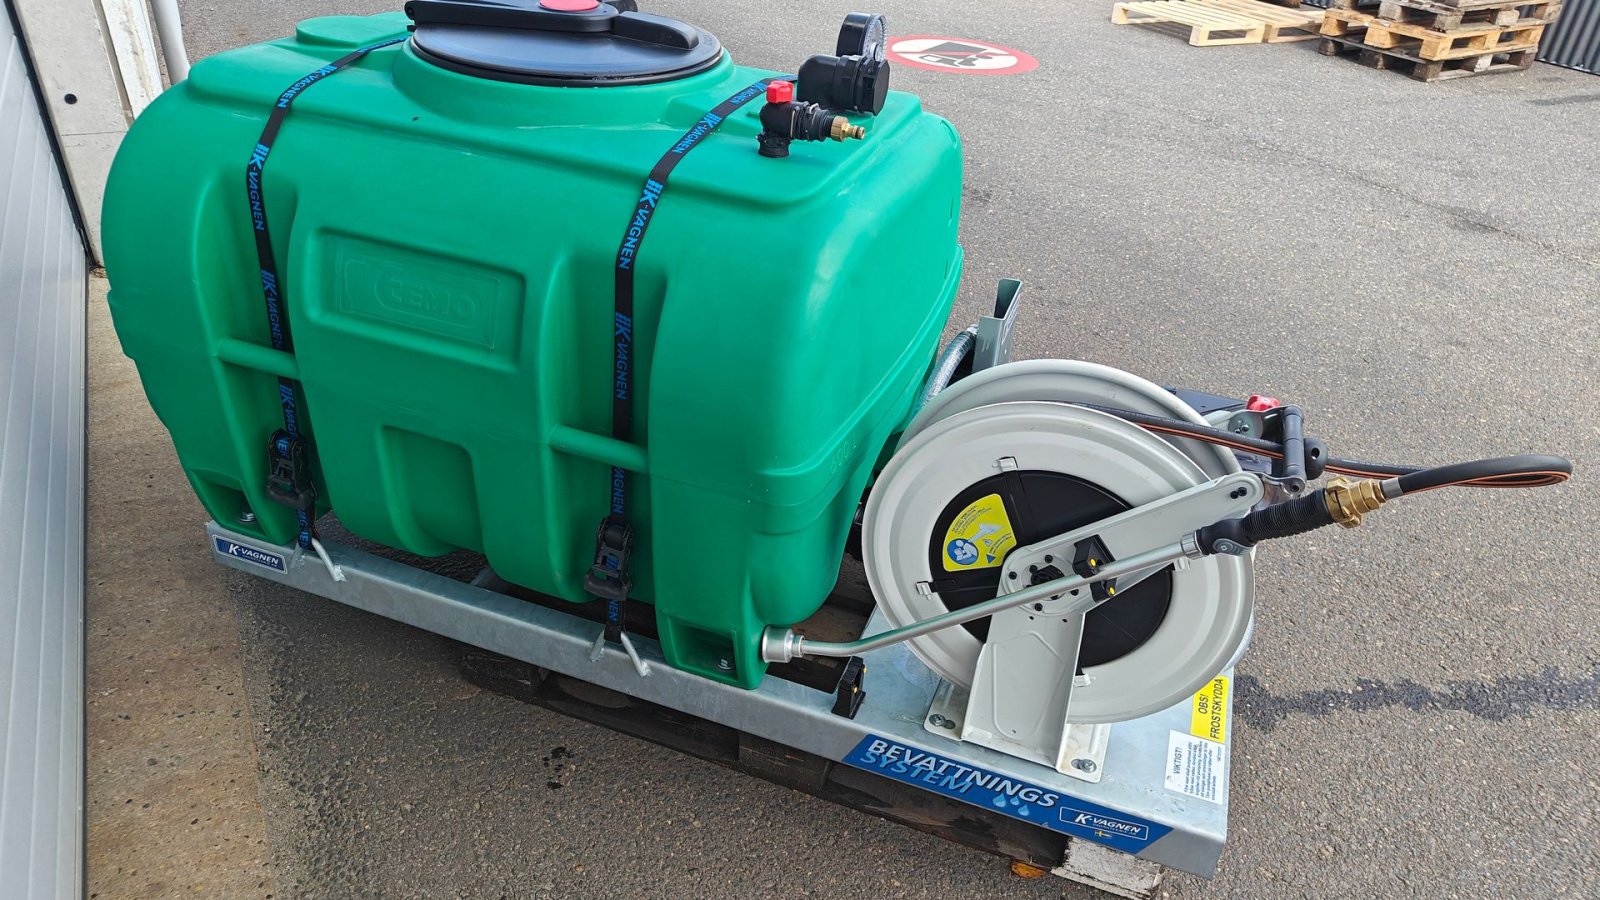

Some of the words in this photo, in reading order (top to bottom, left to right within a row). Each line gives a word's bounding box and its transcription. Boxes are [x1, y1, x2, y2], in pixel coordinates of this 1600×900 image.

[672, 115, 719, 154] K-VAGNEN
[249, 147, 268, 231] K-VAGNEN
[619, 186, 660, 269] K-VAGNEN
[388, 277, 478, 320] CEMO
[614, 317, 631, 400] K-VAGNEN
[228, 543, 279, 565] K-VAGNEN
[1198, 694, 1209, 715] OBS!
[1210, 678, 1224, 740] FROSTSKYDDA
[859, 750, 975, 795] SYSTEM
[867, 739, 1060, 807] BEVATTNINGS
[1173, 747, 1183, 774] VIKTIGT!
[1074, 813, 1141, 834] K-VAGNEN
